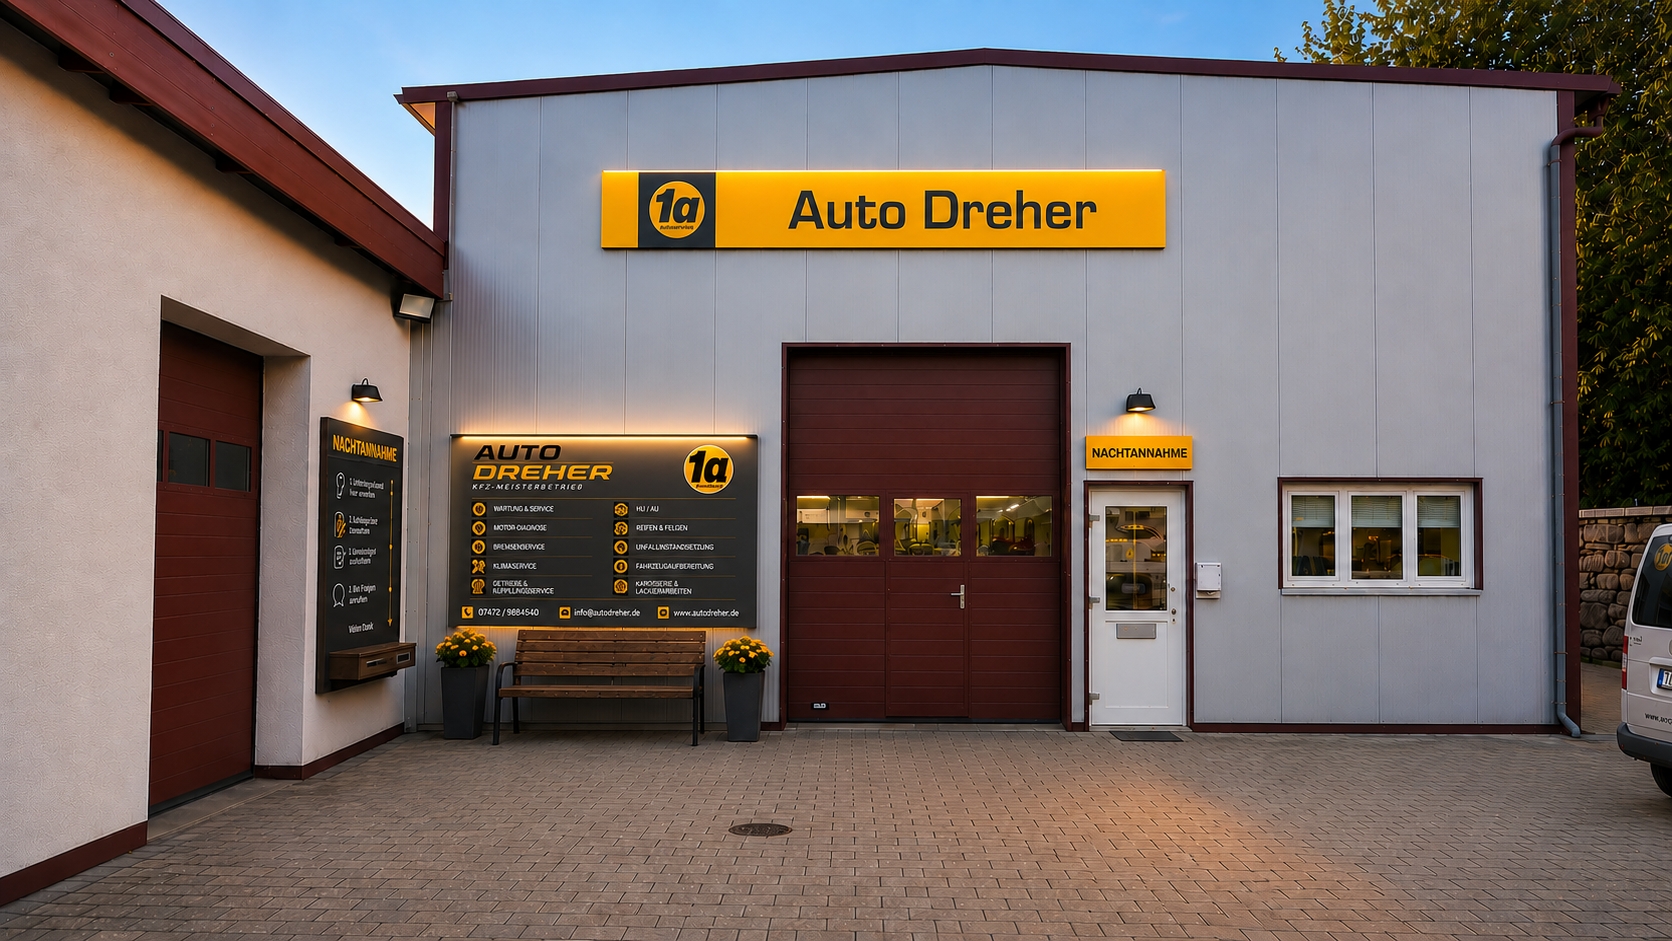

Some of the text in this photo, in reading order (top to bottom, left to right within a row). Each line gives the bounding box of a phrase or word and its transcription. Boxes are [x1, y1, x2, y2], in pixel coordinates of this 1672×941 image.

[656, 188, 700, 223] 1a
[788, 190, 1097, 229] Auto Dreher
[333, 434, 397, 462] NACHTANNAHME
[474, 445, 561, 460] AUTO
[1092, 447, 1187, 458] NACHTANNAHME
[473, 465, 613, 480] DREHER
[689, 451, 729, 483] 1a
[478, 608, 501, 616] 07472
[673, 608, 739, 617] www.autodreher.de
